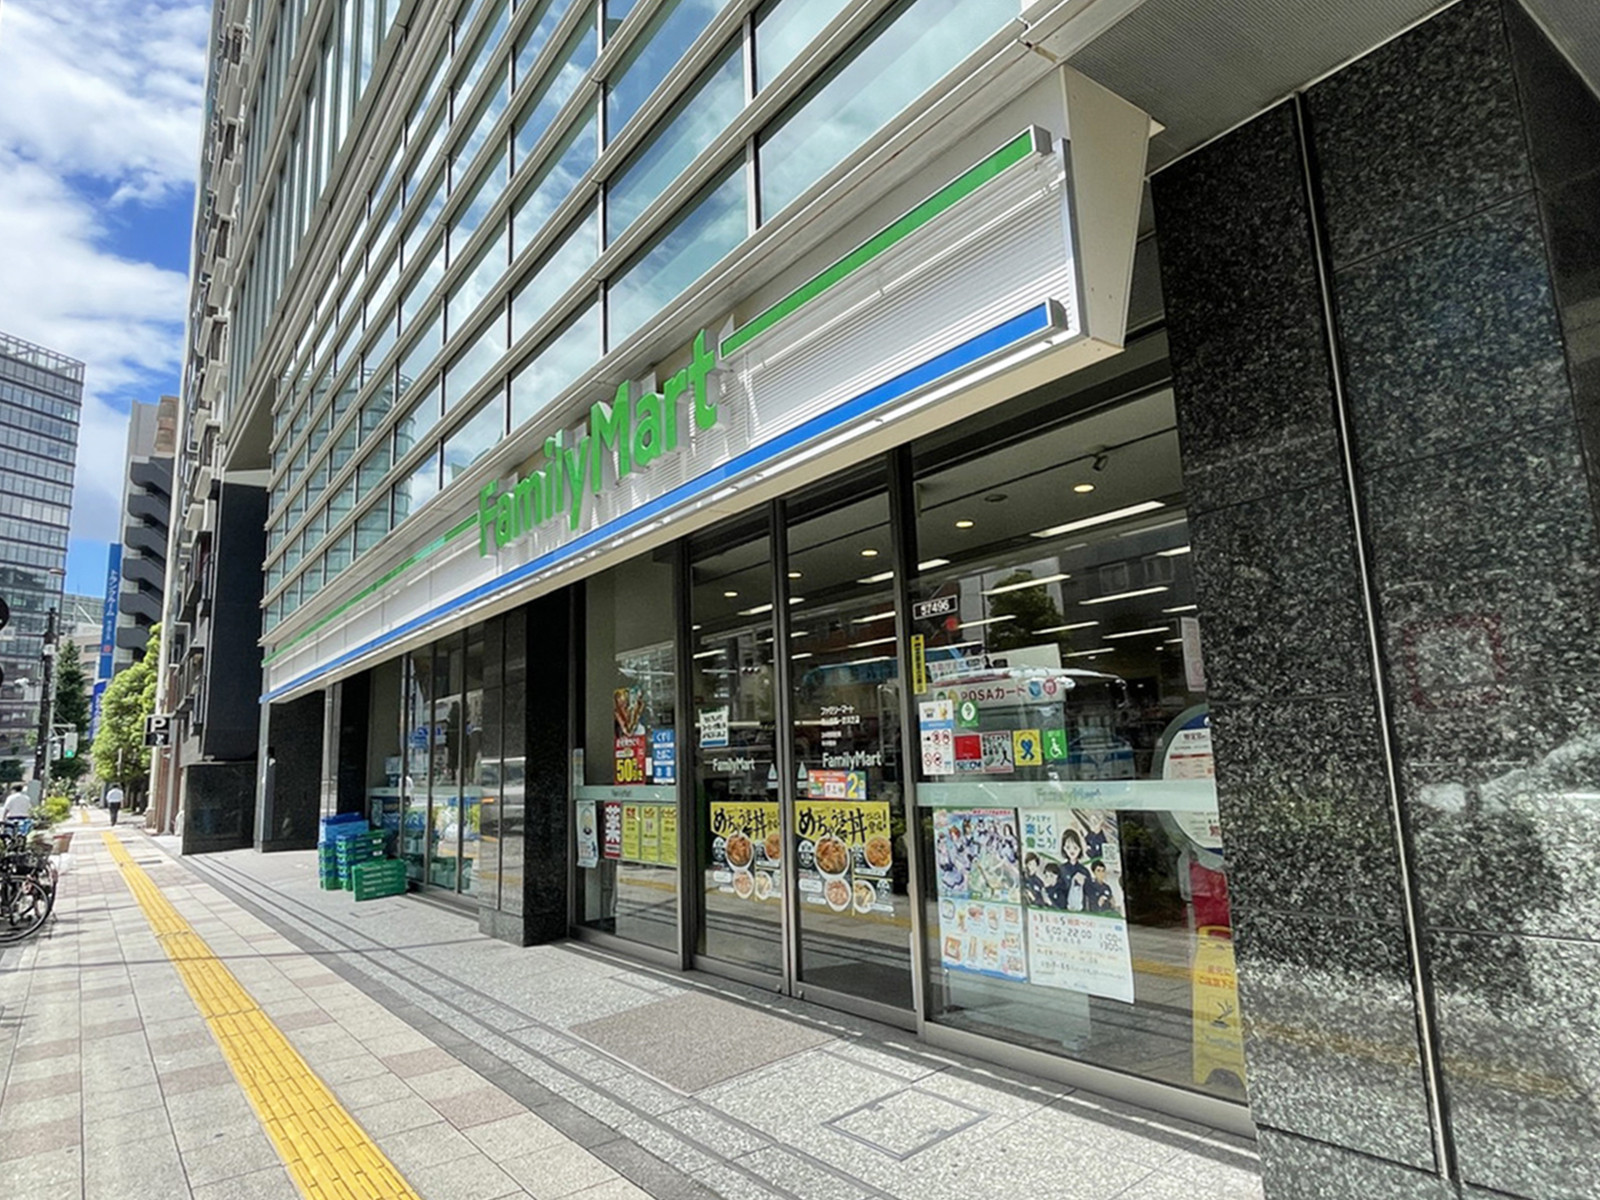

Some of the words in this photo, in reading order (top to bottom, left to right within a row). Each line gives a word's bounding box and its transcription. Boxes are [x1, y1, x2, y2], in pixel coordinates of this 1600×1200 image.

[479, 328, 718, 558] FamilyMart
[151, 717, 167, 732] P
[713, 757, 755, 775] FamilyMart
[822, 751, 882, 771] FamilyMart
